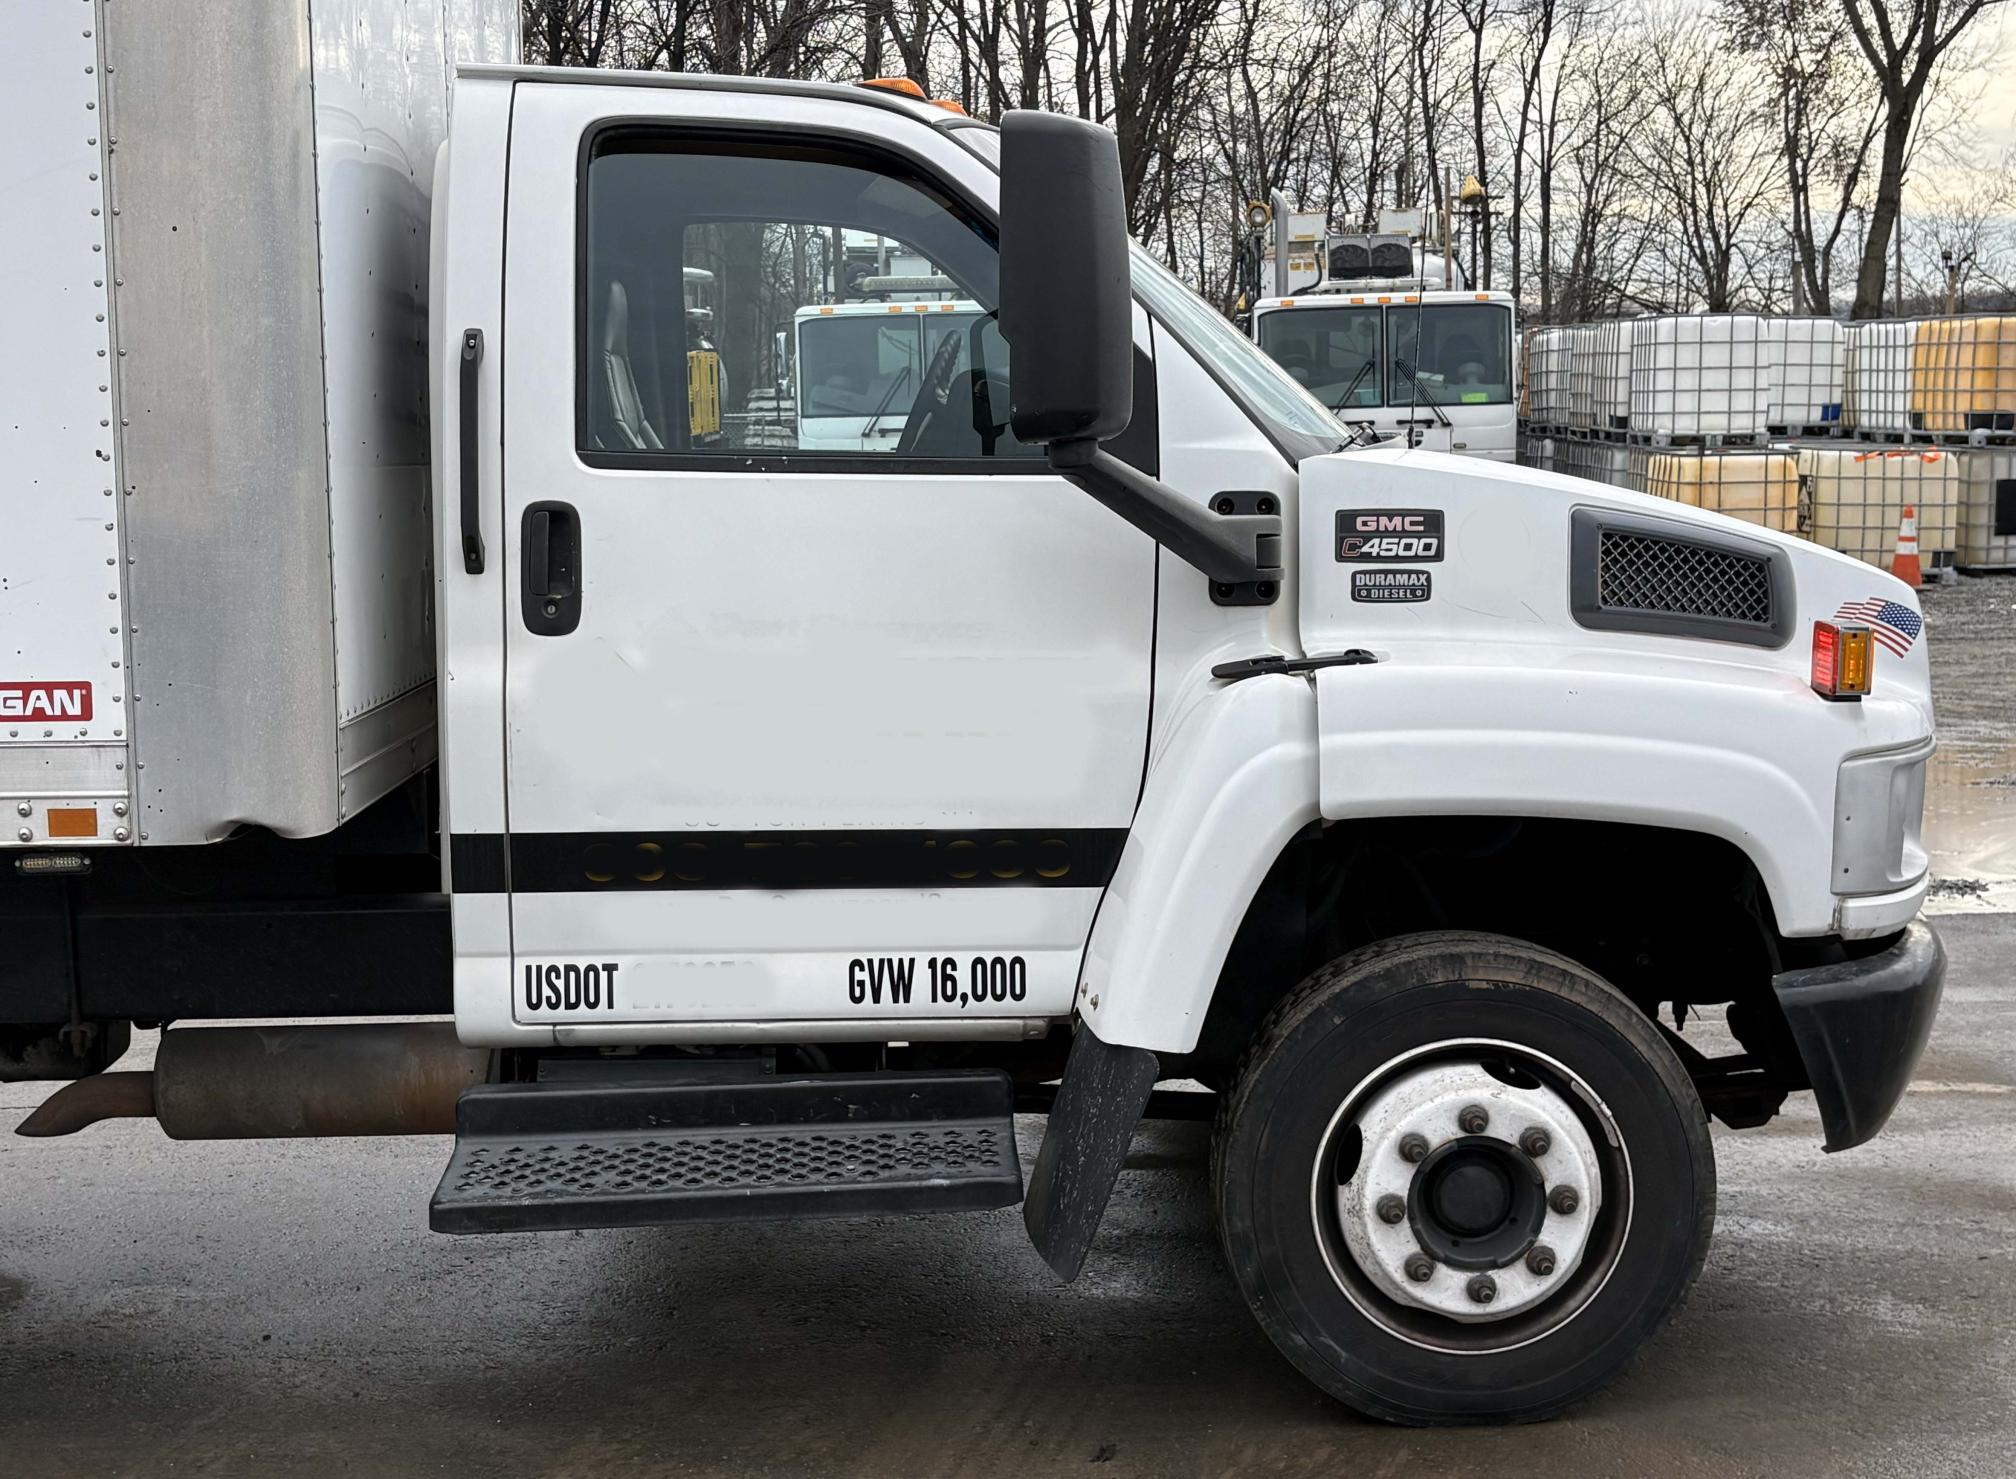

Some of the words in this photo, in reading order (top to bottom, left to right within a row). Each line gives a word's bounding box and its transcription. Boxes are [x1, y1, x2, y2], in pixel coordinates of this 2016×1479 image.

[1356, 516, 1424, 532] GMC
[1341, 537, 1438, 557] C4500
[1355, 573, 1428, 586] DURAMAX
[1371, 588, 1413, 599] DIESEL
[525, 963, 619, 1011] USDOT
[848, 957, 916, 1005] GVW
[927, 956, 1027, 1009] 16,000
